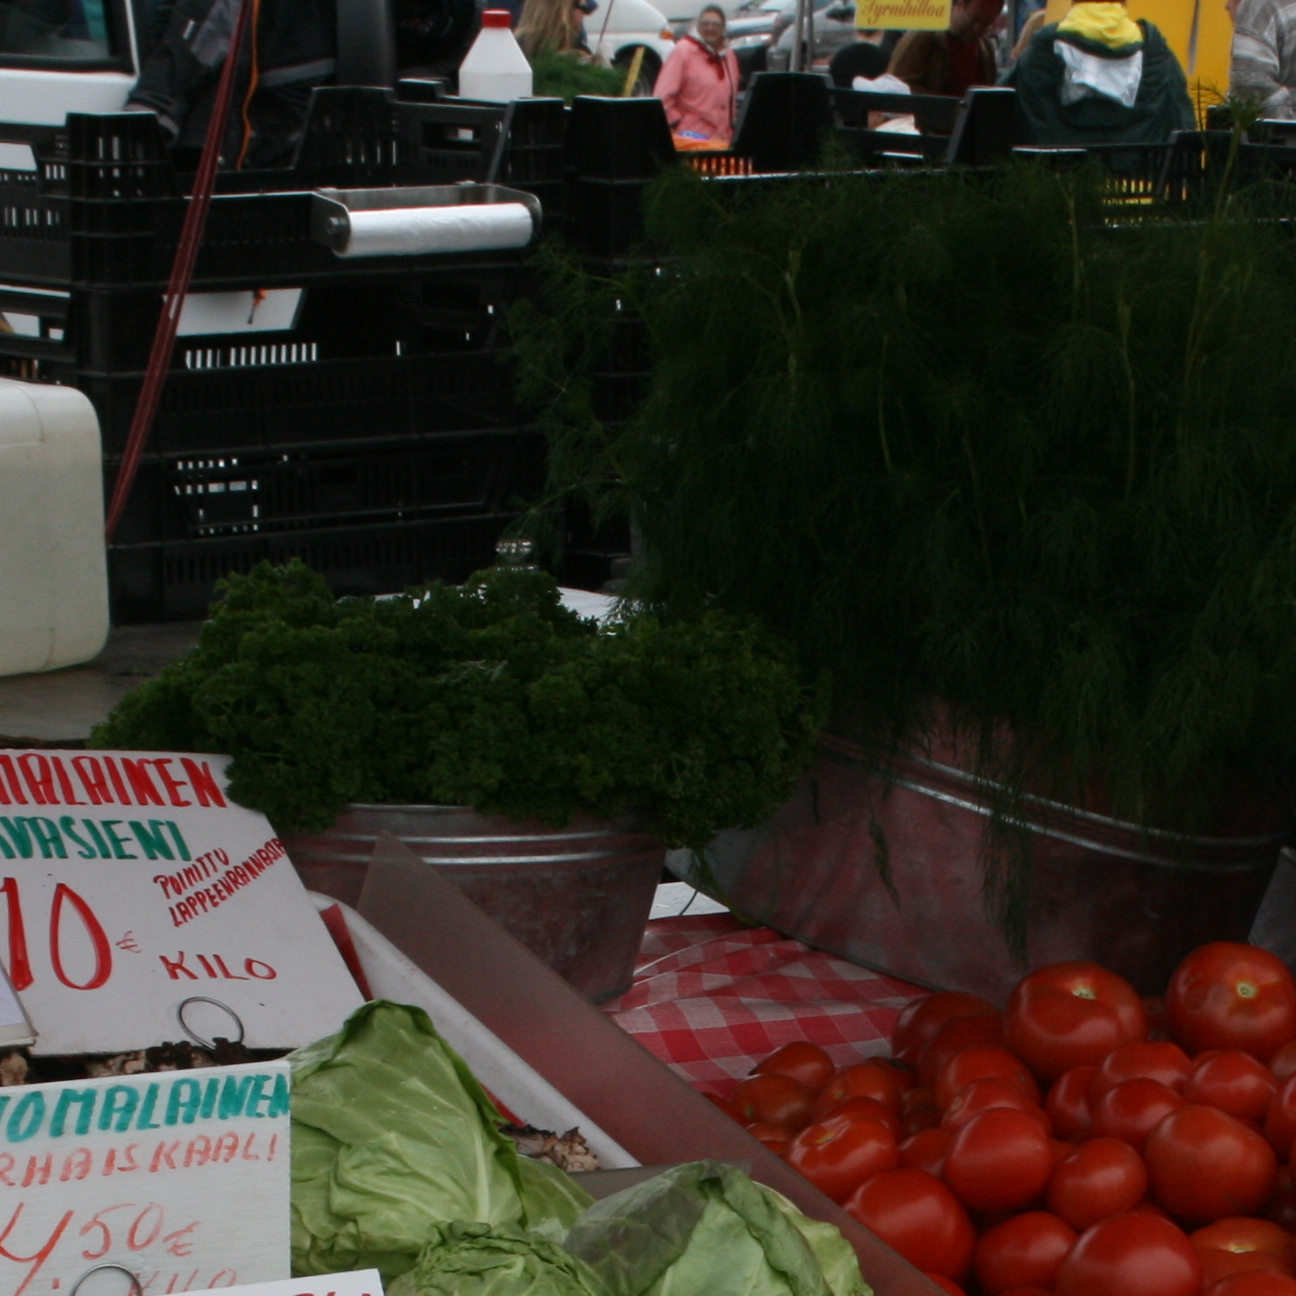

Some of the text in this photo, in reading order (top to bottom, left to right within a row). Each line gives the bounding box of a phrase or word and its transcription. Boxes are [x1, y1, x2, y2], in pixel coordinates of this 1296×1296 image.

[153, 847, 231, 900] POIMITTU
[113, 929, 143, 956] €
[158, 950, 279, 981] KILO
